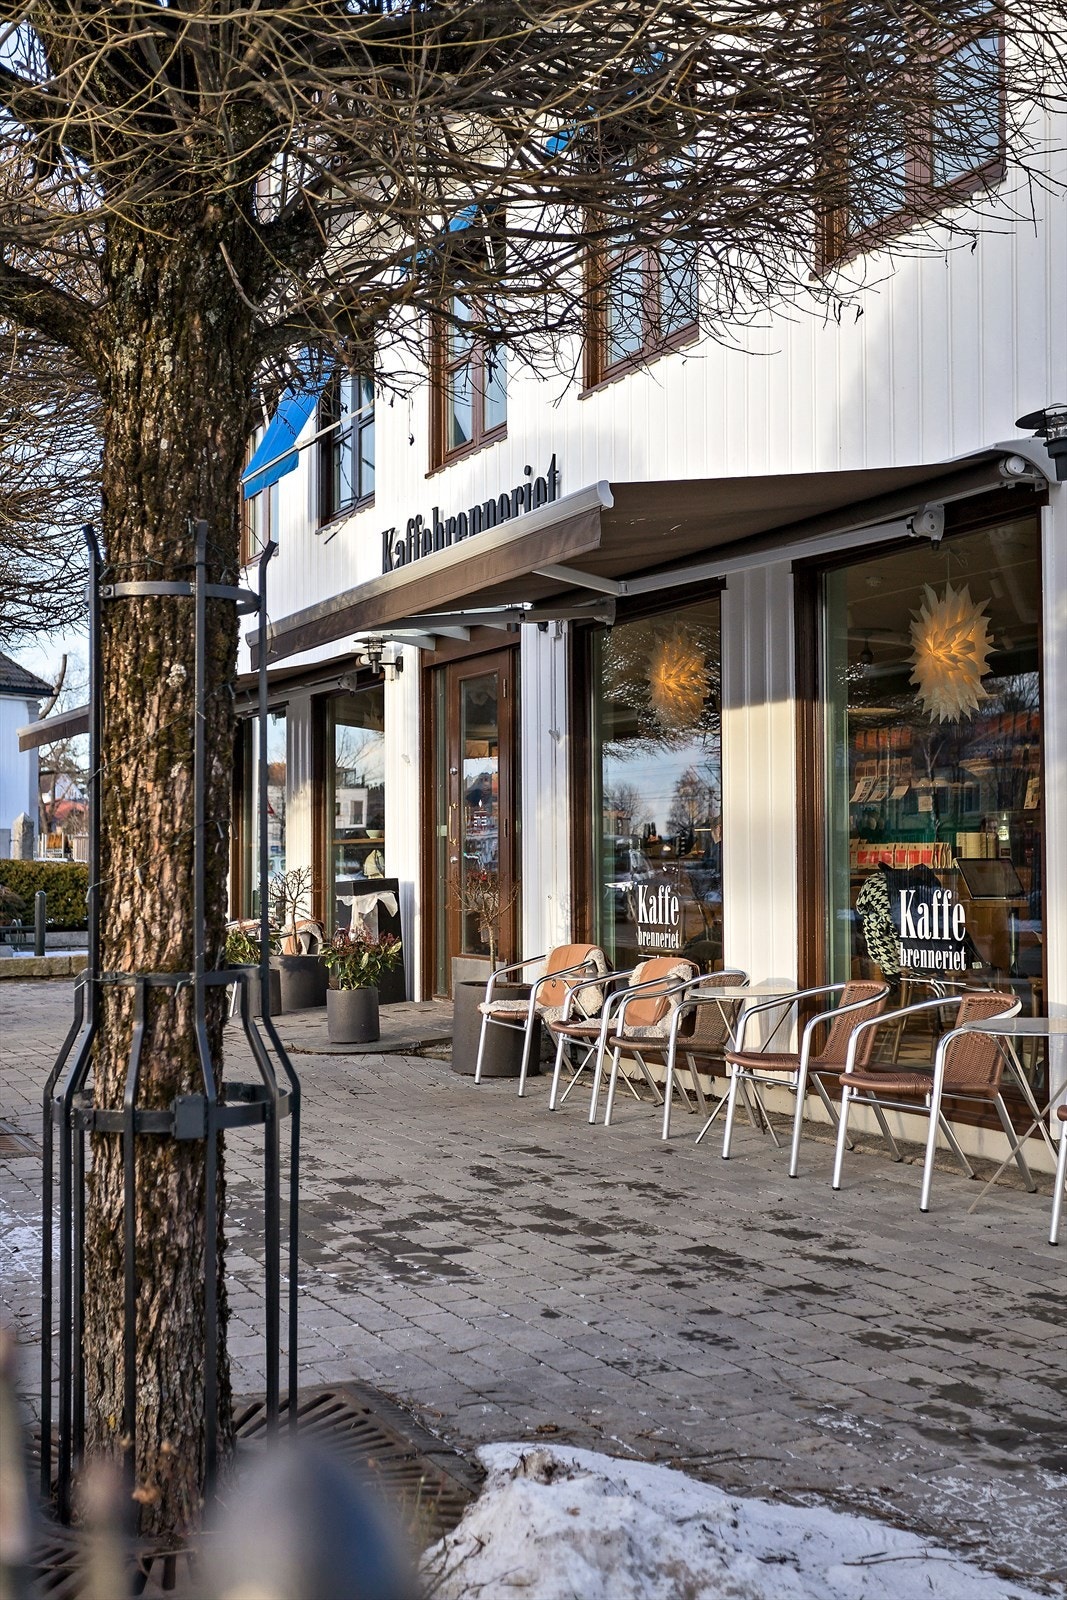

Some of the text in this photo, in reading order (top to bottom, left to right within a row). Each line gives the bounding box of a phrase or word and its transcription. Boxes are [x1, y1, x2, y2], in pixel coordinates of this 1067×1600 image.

[382, 453, 559, 574] Kaffebrenneriet
[638, 885, 679, 925] Kaffe
[899, 890, 966, 941] Kaffe
[638, 926, 679, 949] brenneriet
[900, 942, 966, 971] brenneriet
